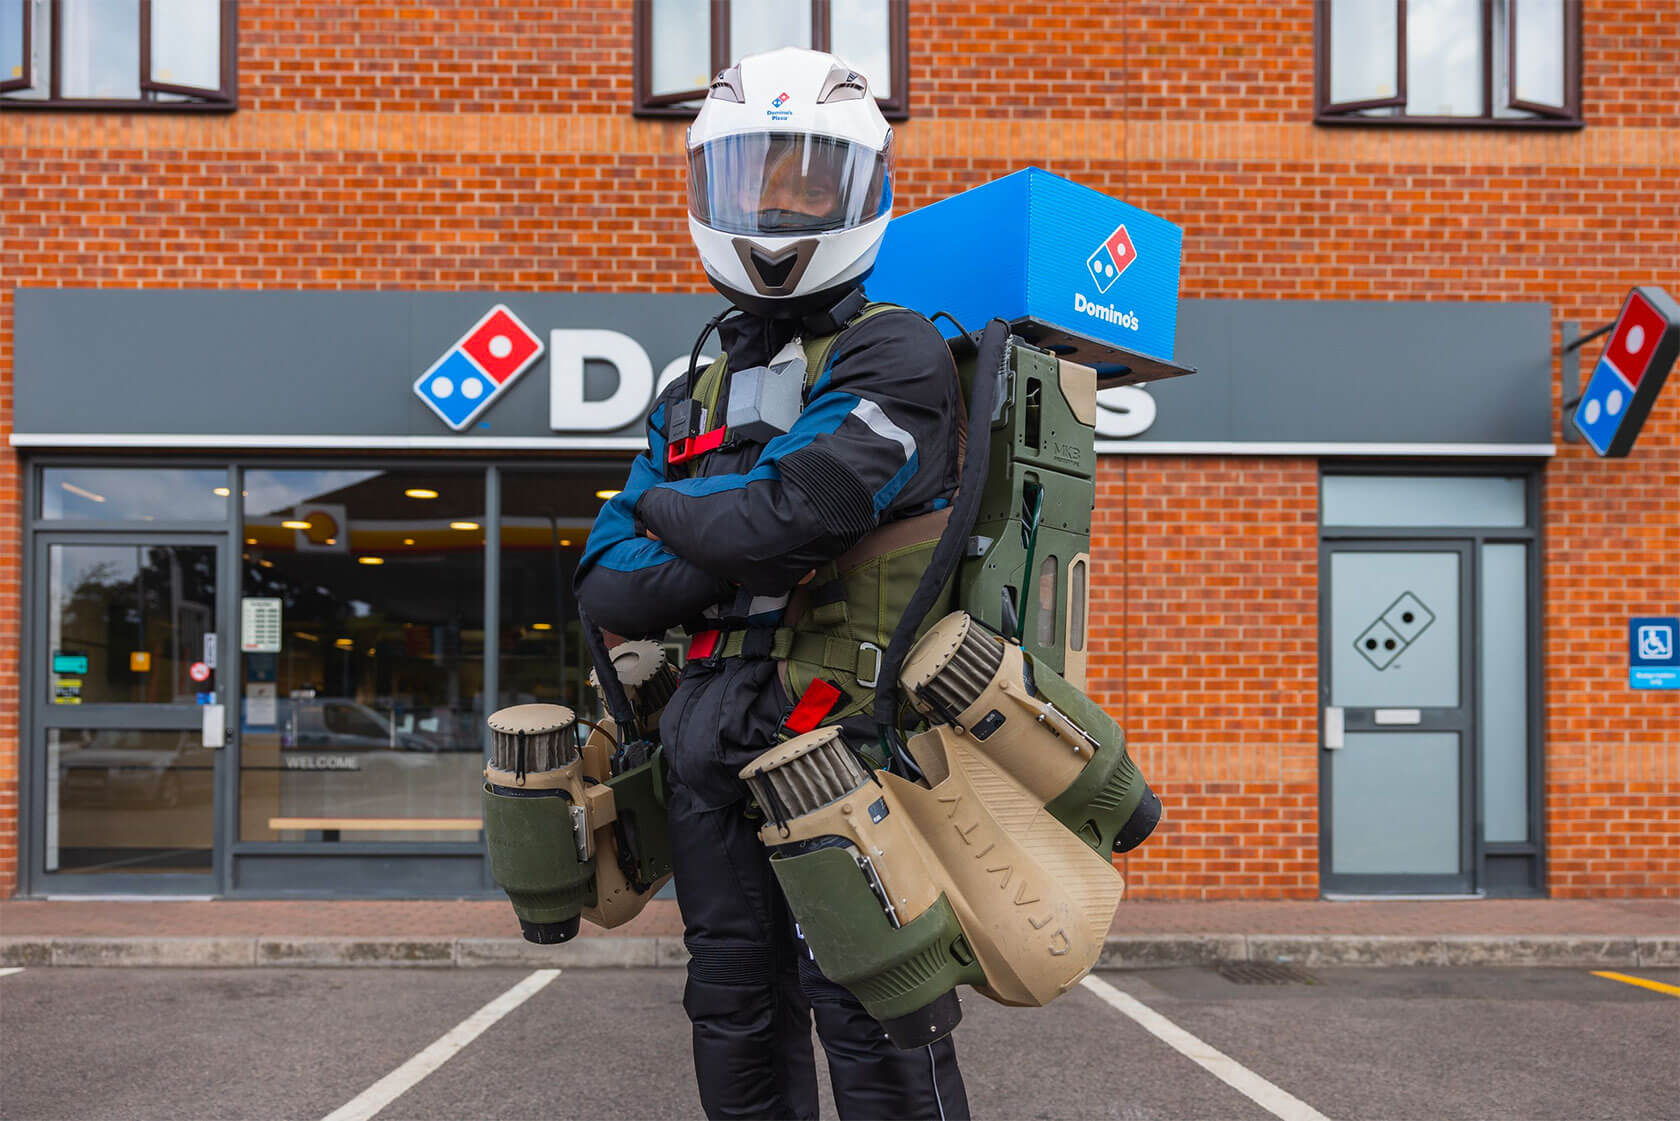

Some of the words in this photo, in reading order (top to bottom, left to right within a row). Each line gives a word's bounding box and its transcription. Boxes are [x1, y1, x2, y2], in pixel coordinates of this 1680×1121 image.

[1074, 292, 1139, 331] Domino's
[286, 756, 359, 769] WELCOME
[937, 795, 1072, 956] GRAVITY
